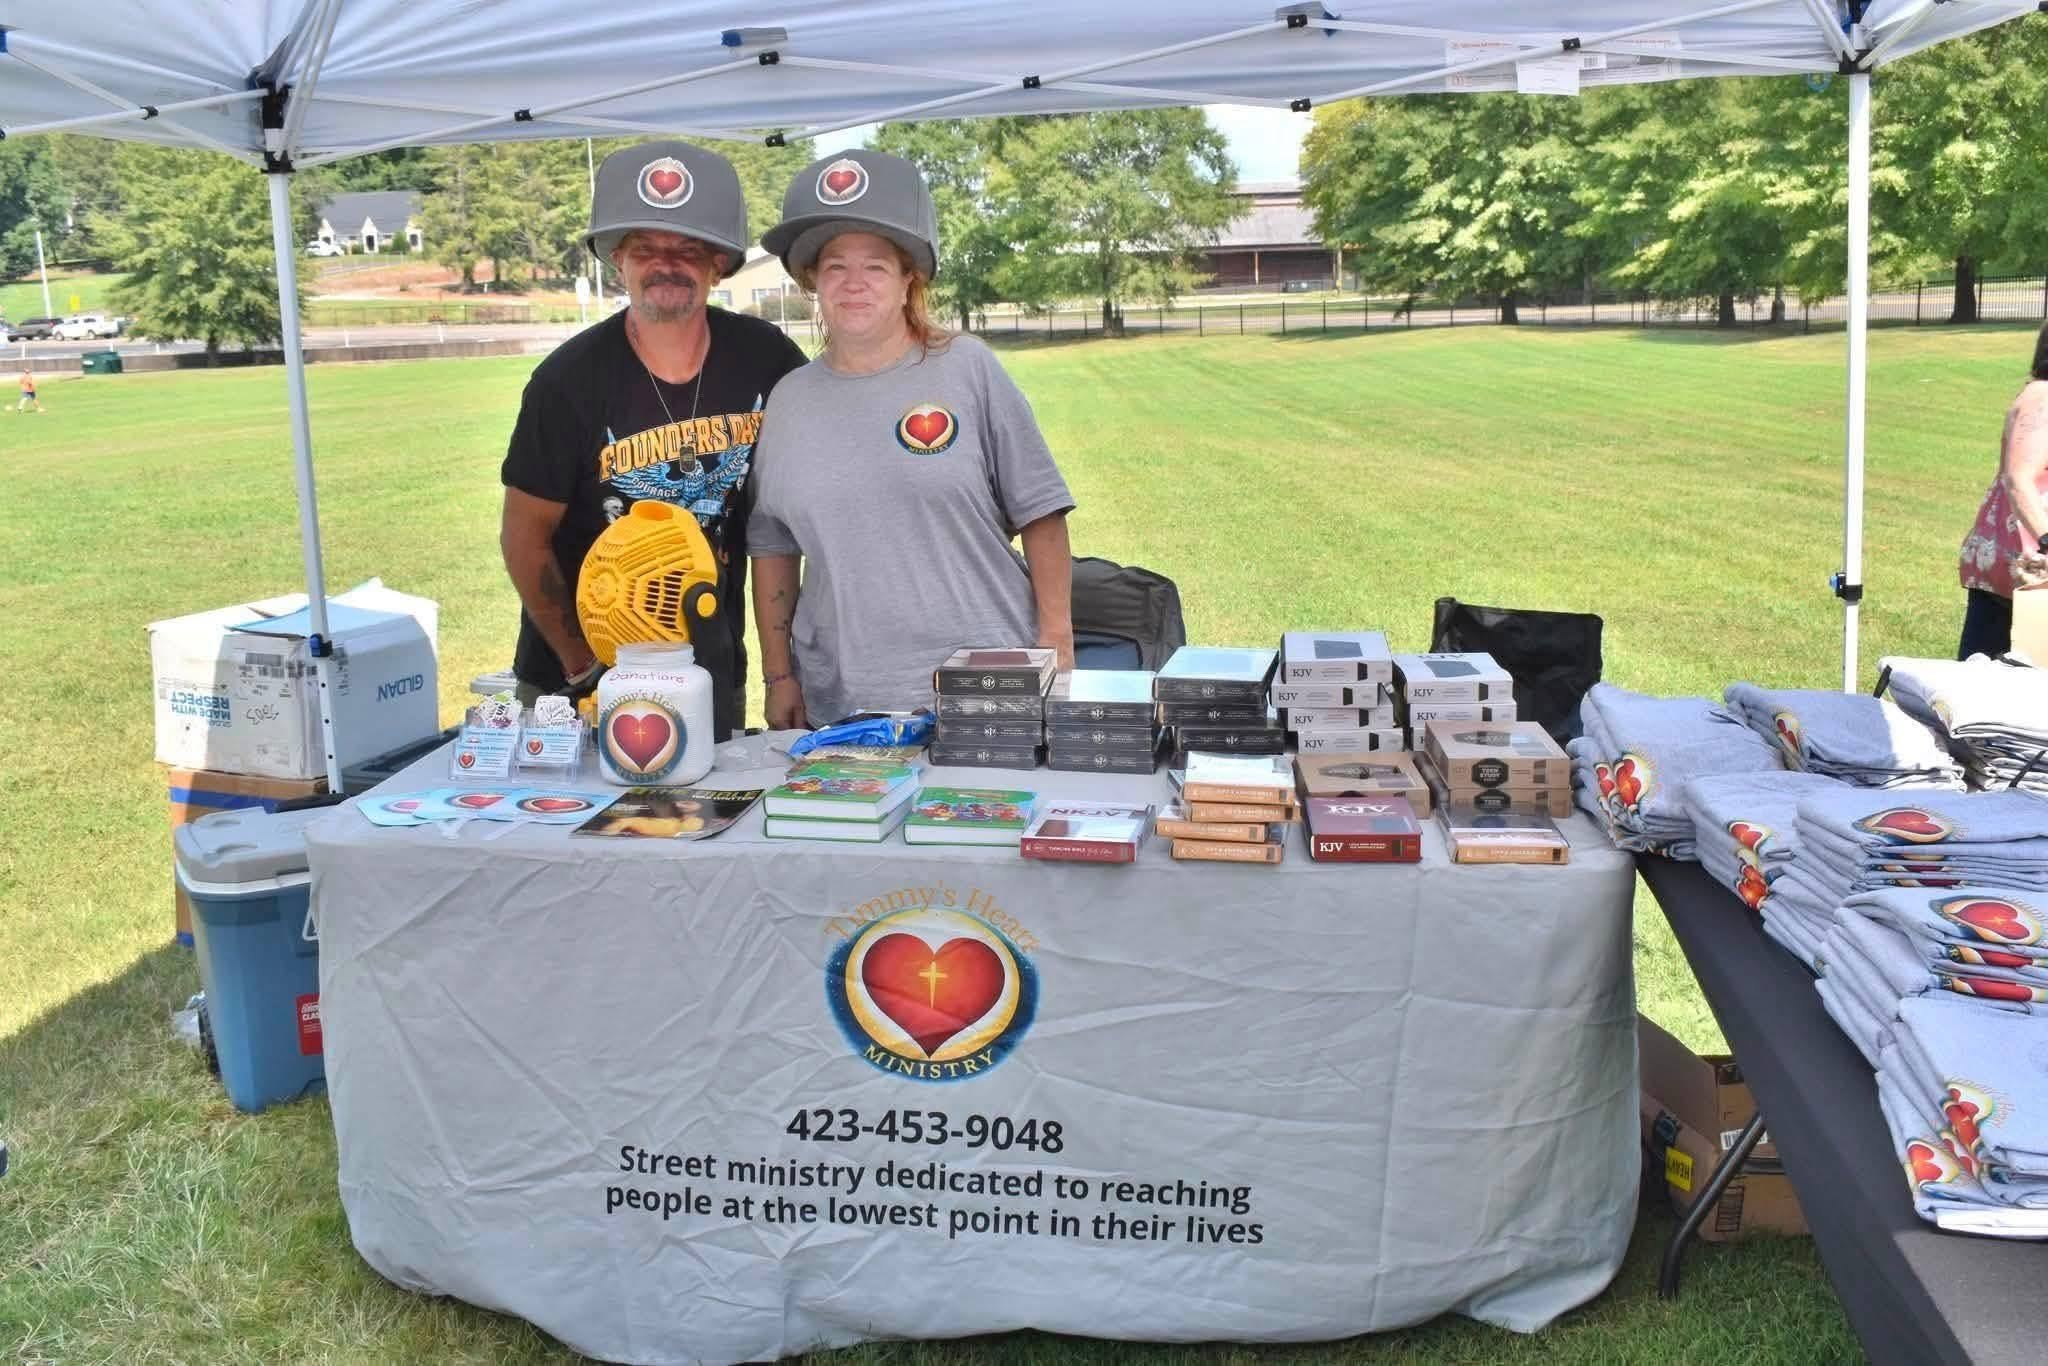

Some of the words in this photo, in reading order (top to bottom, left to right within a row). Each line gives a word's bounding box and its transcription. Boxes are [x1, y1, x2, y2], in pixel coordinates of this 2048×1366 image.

[600, 415, 728, 481] FOUNDERS
[631, 477, 678, 498] COURAGE
[1292, 668, 1312, 677] KJV
[376, 674, 424, 702] GILDAN
[1414, 688, 1434, 697] KJV
[171, 691, 230, 709] RESPECT
[1278, 692, 1298, 701] KJV
[171, 704, 196, 717] WITH
[200, 708, 231, 721] MADE
[1416, 712, 1437, 720] KJV
[1294, 715, 1314, 724] KJV
[1304, 739, 1324, 748] KJV
[1050, 808, 1122, 817] NKJV
[1328, 804, 1393, 814] KJV
[1319, 842, 1343, 852] KJV
[823, 880, 958, 938] Timmy's
[967, 887, 1041, 953] Heart
[863, 1043, 994, 1079] MINISTRY
[786, 1108, 1064, 1154] 423-453-9048
[620, 1145, 717, 1179] Street
[727, 1156, 866, 1195] ministry
[875, 1159, 1043, 1197] dedicated
[1054, 1175, 1089, 1200] to
[1100, 1180, 1252, 1215] reaching
[606, 1186, 712, 1221] people
[722, 1195, 755, 1221] at
[762, 1196, 818, 1224] the
[829, 1196, 939, 1228] lowest
[949, 1206, 1040, 1240] point
[1050, 1208, 1080, 1237] in
[1091, 1211, 1177, 1241] their
[1186, 1215, 1264, 1244] lives
